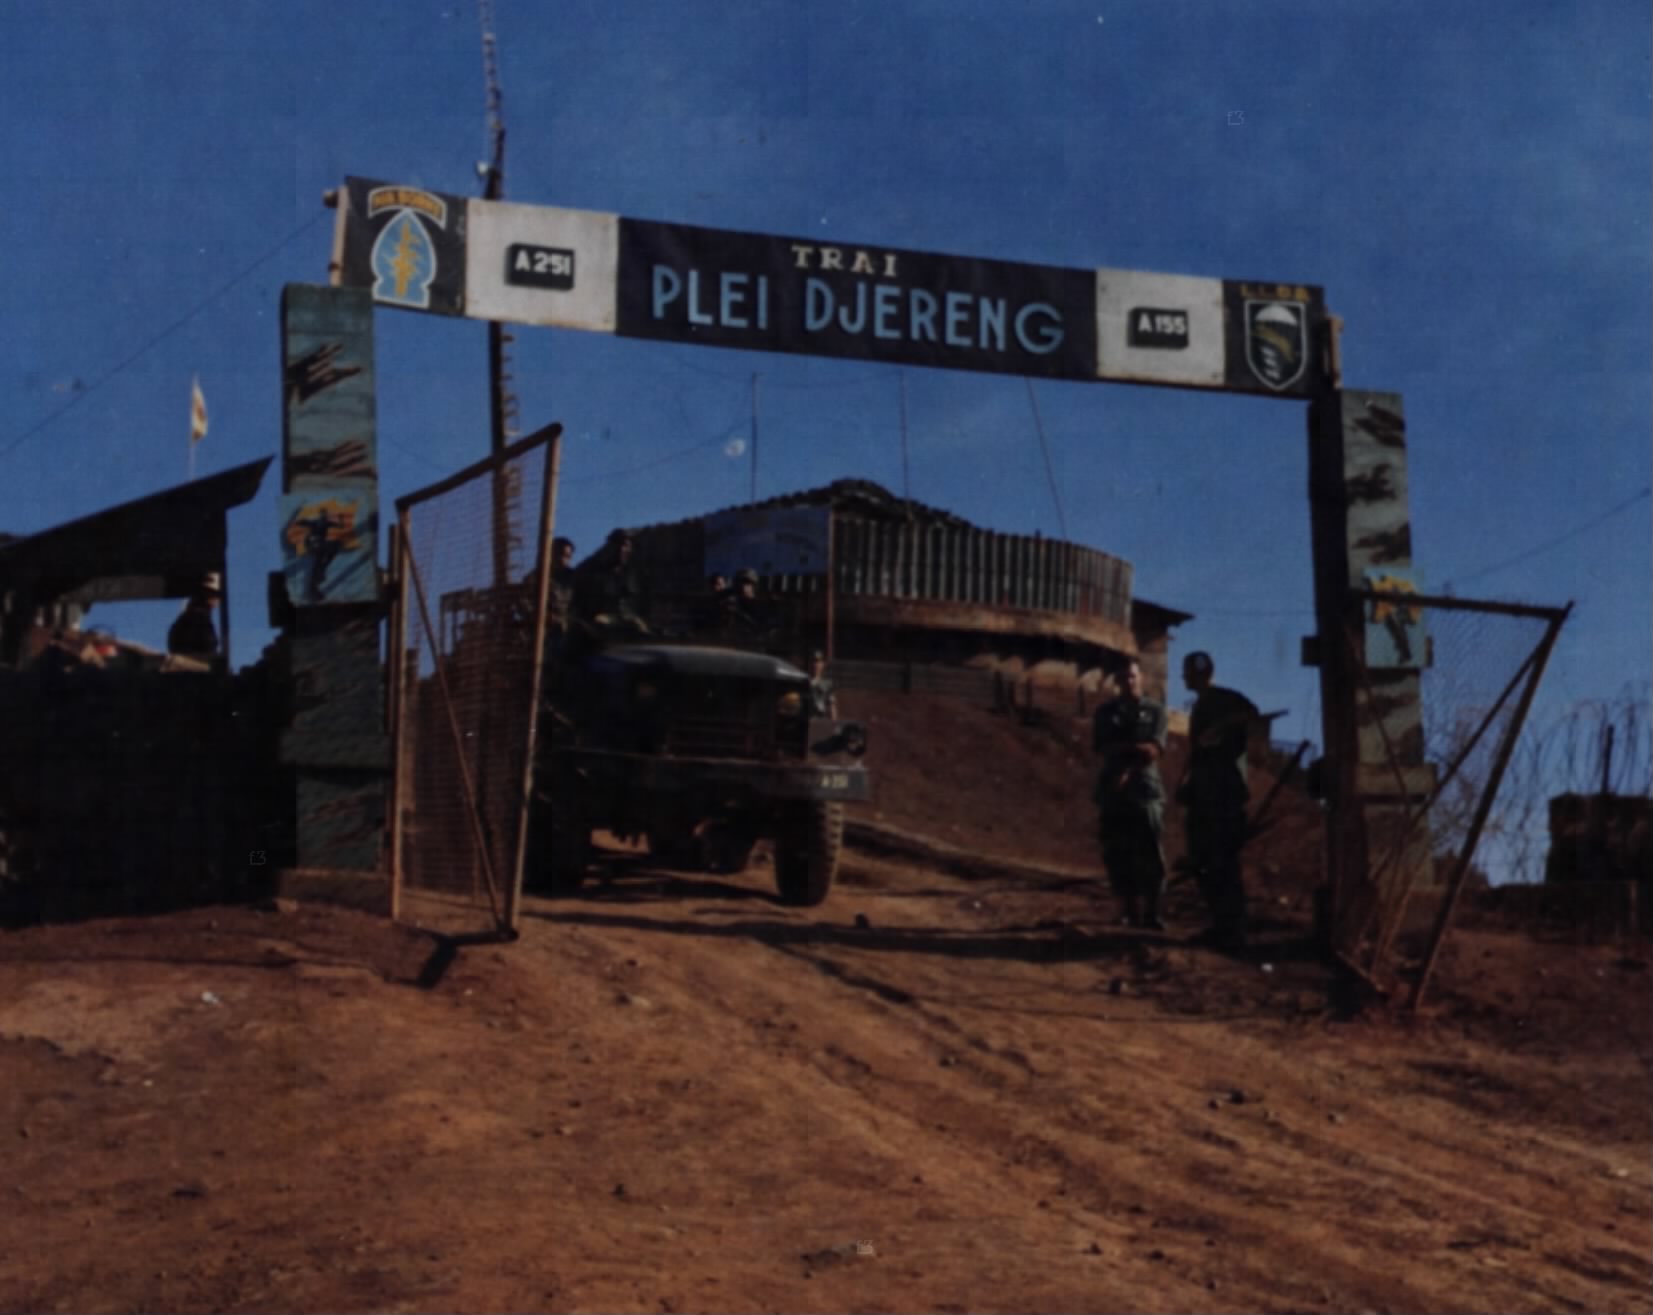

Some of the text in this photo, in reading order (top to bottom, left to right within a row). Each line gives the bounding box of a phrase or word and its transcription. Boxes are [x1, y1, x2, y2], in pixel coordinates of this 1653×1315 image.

[790, 244, 899, 277] TRAI
[651, 264, 1065, 355] PLEI DJERENG
